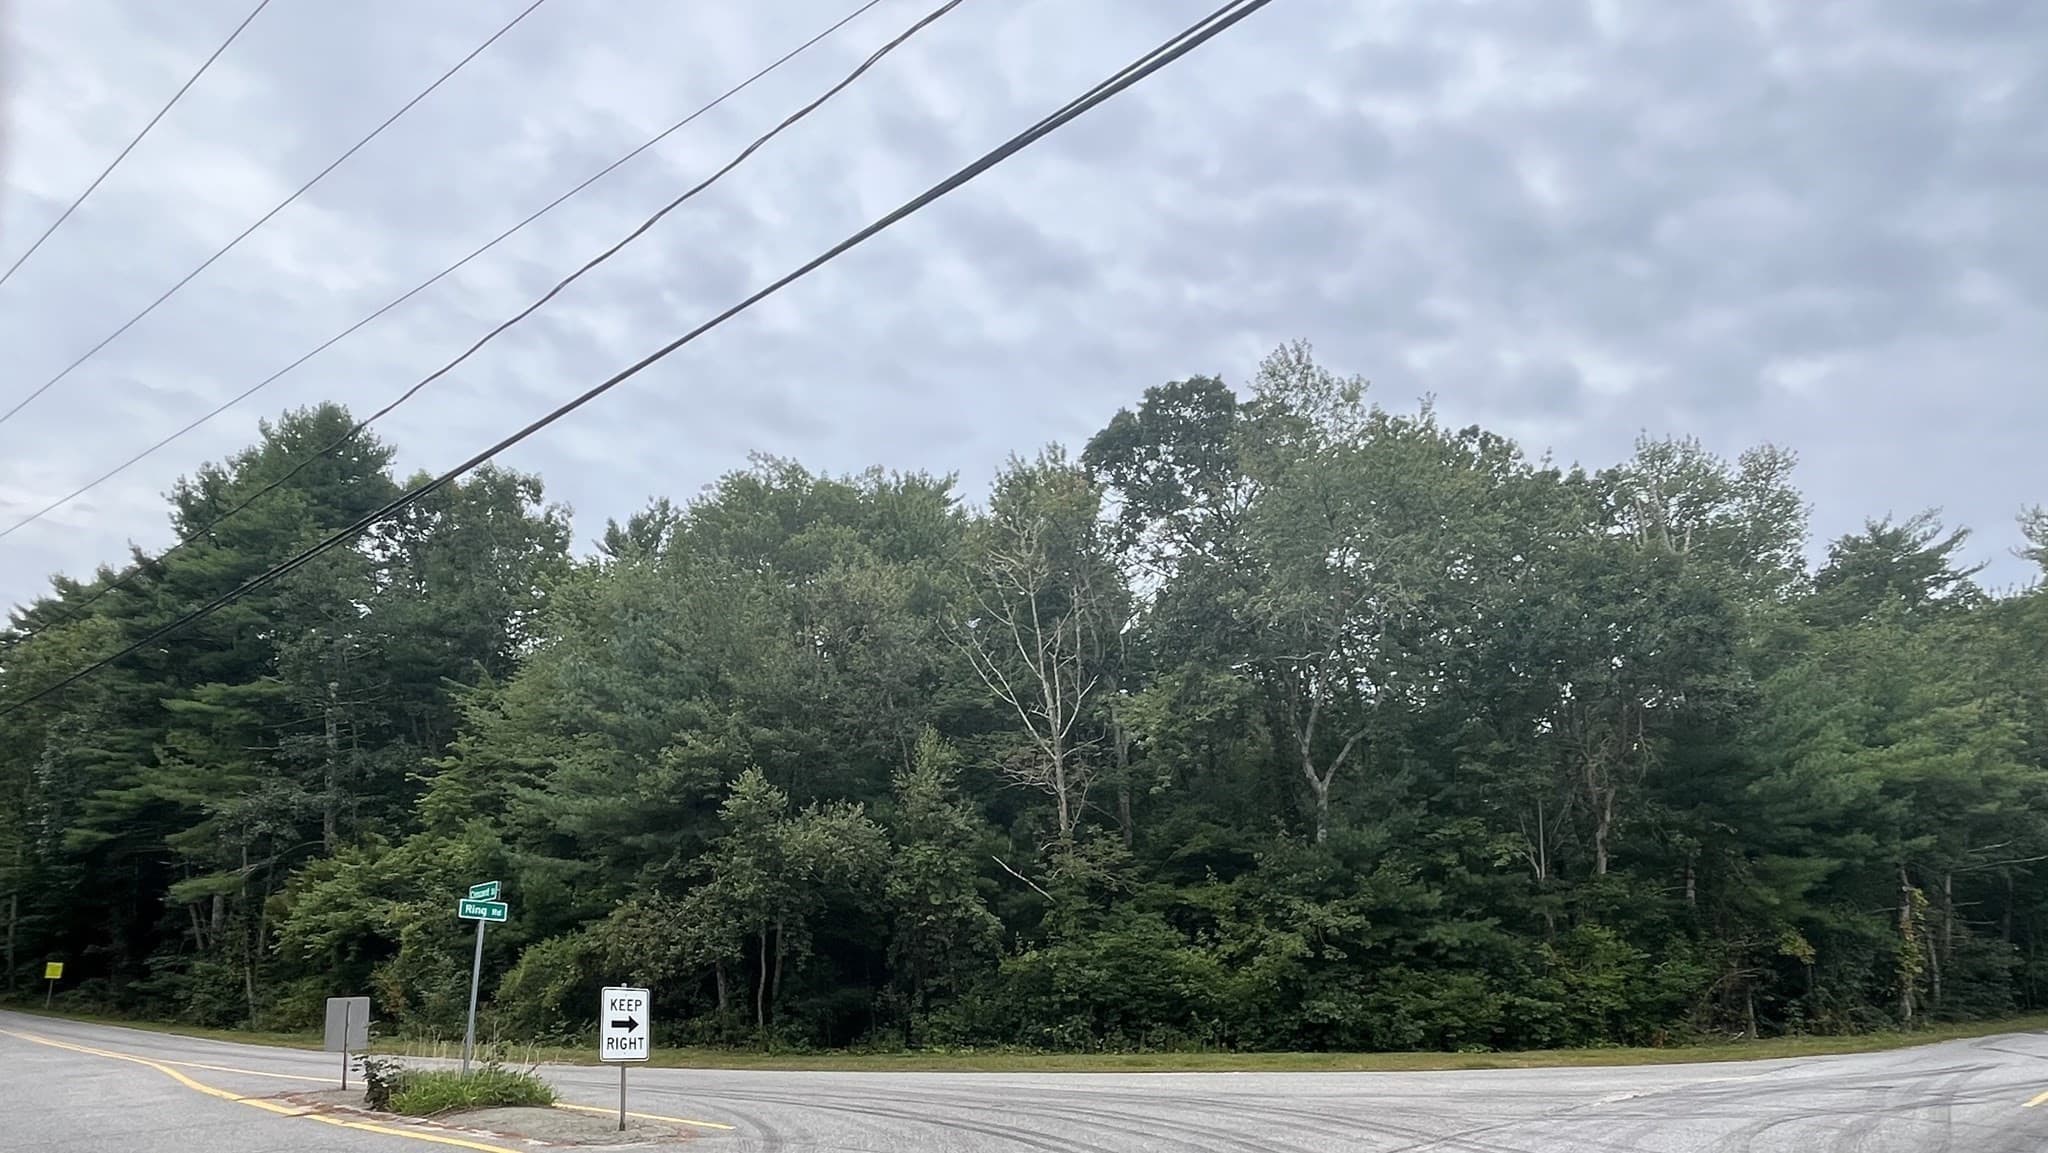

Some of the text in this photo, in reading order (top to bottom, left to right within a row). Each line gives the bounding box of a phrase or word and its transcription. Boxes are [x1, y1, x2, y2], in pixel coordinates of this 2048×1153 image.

[465, 904, 487, 916] Ring
[610, 998, 642, 1012] KEEP
[607, 1037, 645, 1050] RIGHT
